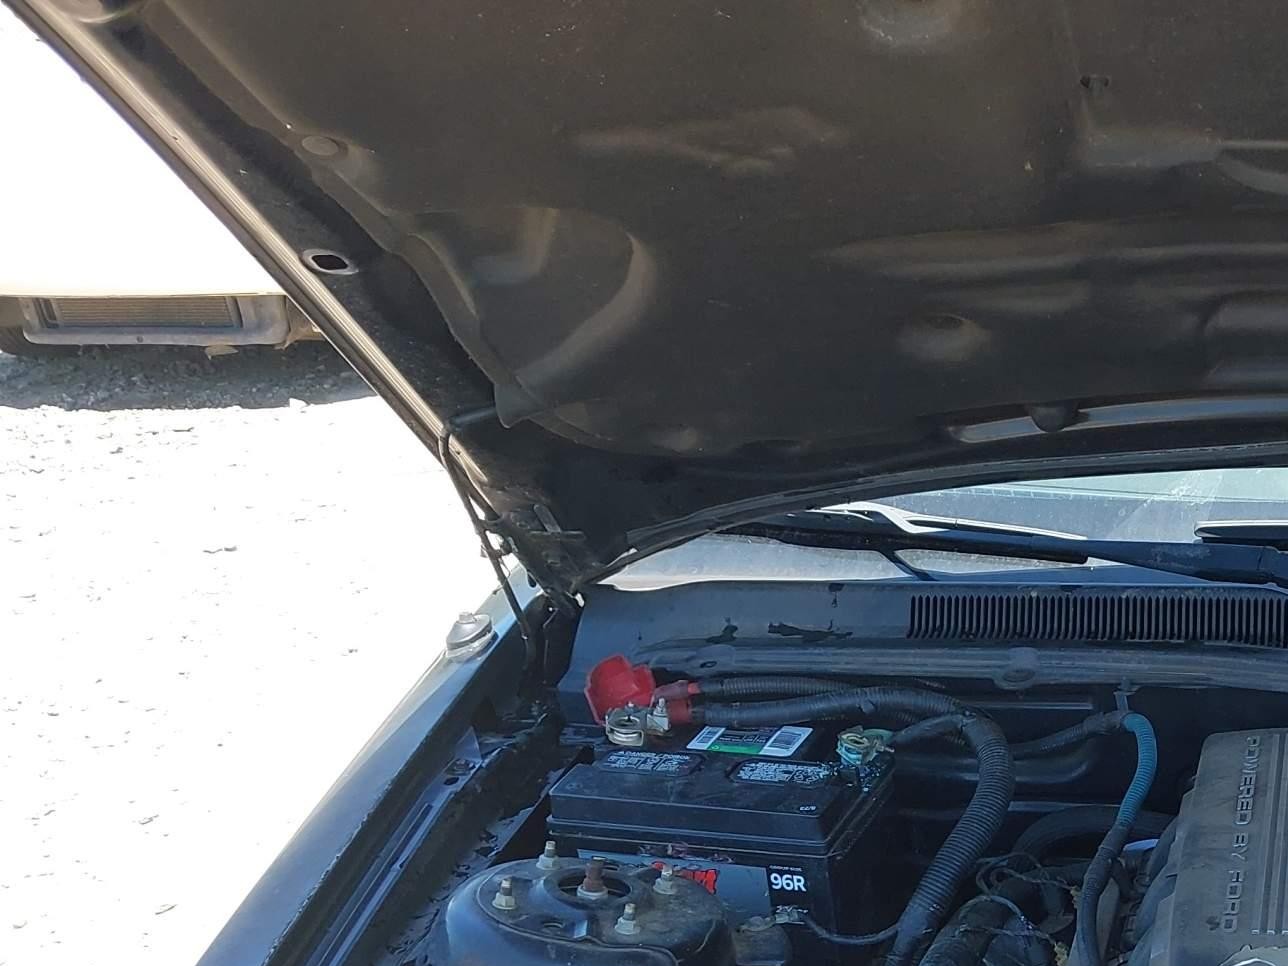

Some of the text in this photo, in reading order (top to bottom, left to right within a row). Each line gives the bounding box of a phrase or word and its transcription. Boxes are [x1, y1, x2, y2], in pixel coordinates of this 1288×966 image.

[770, 872, 807, 892] 96R
[1221, 736, 1260, 933] POWERED BY FORD
